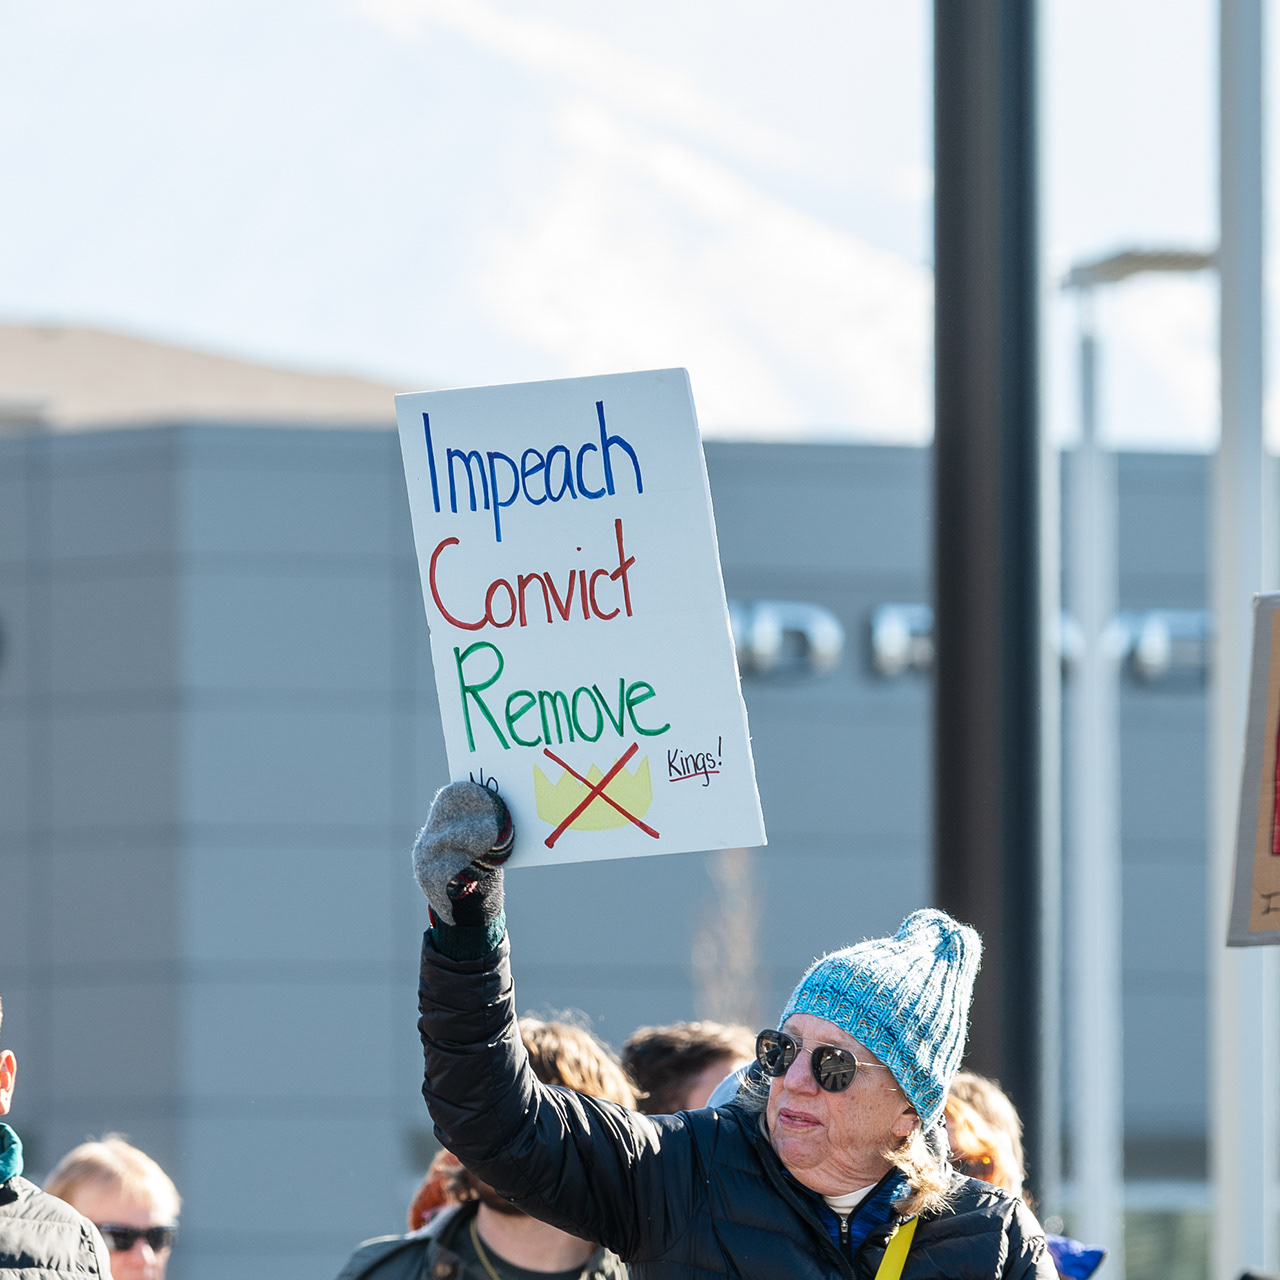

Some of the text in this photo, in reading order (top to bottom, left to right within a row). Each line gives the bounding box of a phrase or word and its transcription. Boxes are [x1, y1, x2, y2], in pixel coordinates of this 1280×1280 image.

[422, 400, 643, 542] Impeach
[429, 518, 636, 631] Convict
[453, 641, 671, 752] Remove
[668, 736, 722, 787] Kings!
